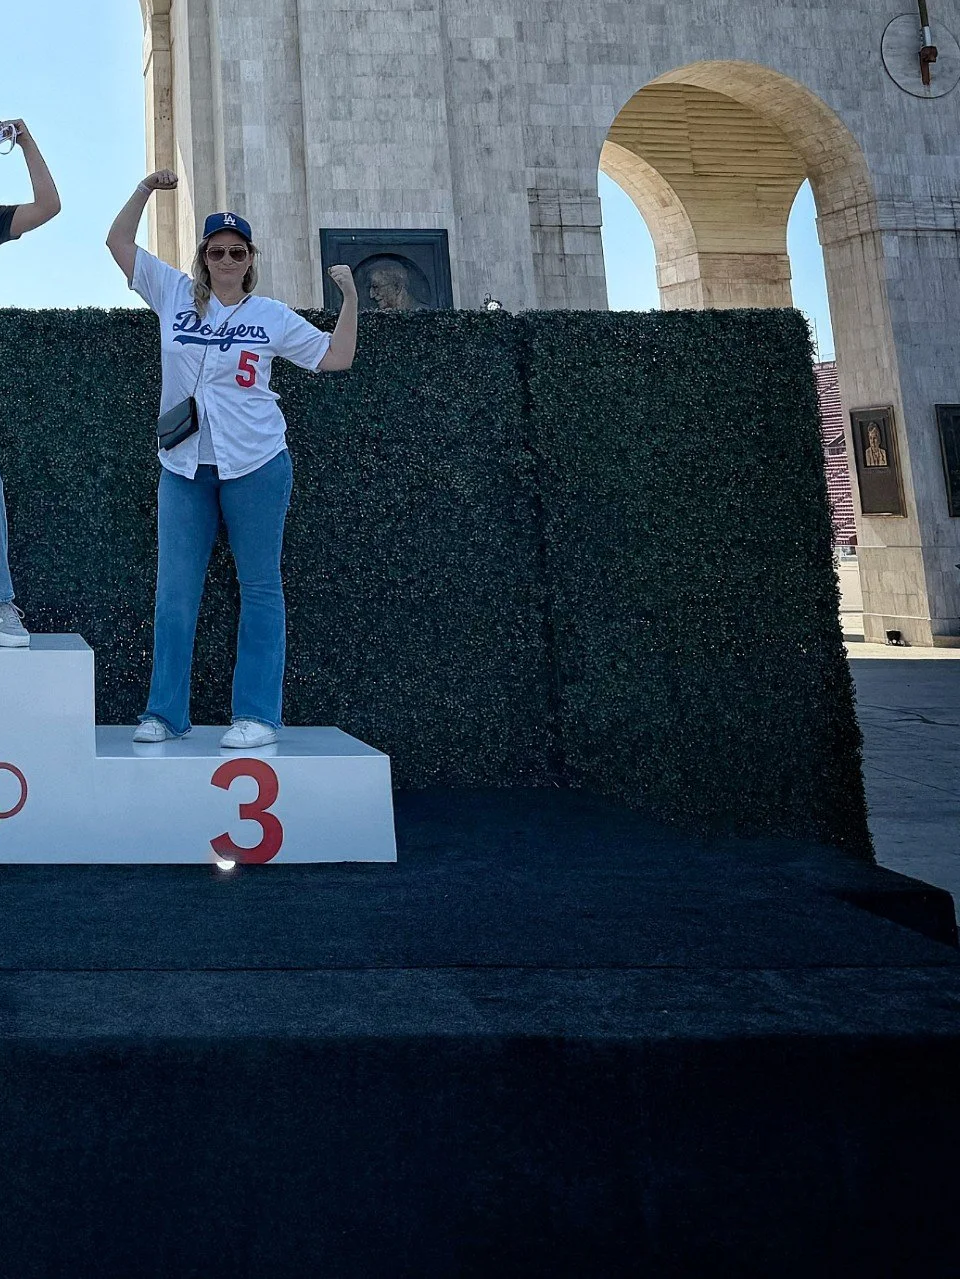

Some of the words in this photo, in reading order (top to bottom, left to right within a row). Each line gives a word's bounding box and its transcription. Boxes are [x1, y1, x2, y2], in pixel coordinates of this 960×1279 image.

[223, 213, 237, 226] LA
[172, 310, 270, 352] Dodgers
[235, 350, 260, 388] 5
[210, 758, 283, 864] 3
